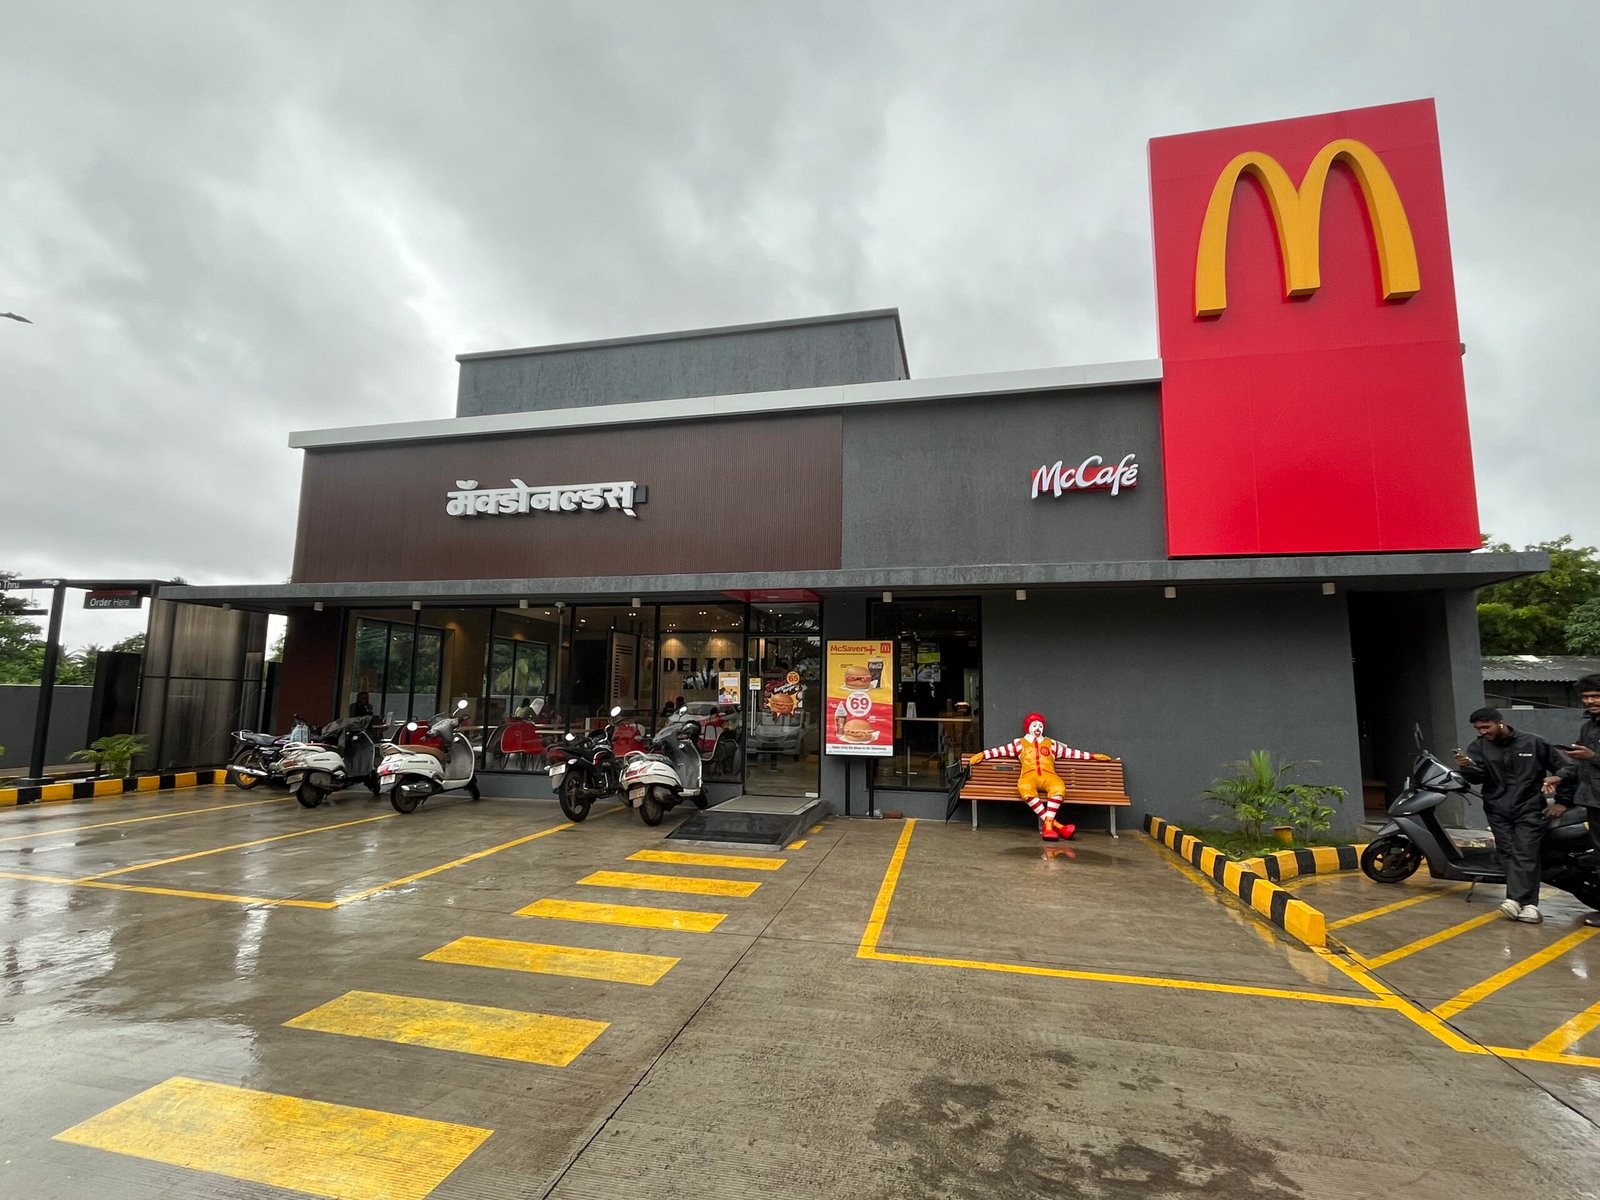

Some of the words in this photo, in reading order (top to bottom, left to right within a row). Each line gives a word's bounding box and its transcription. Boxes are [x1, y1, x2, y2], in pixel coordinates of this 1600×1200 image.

[1031, 453, 1139, 499] McCafé
[89, 598, 112, 607] Order
[850, 697, 870, 710] 69
